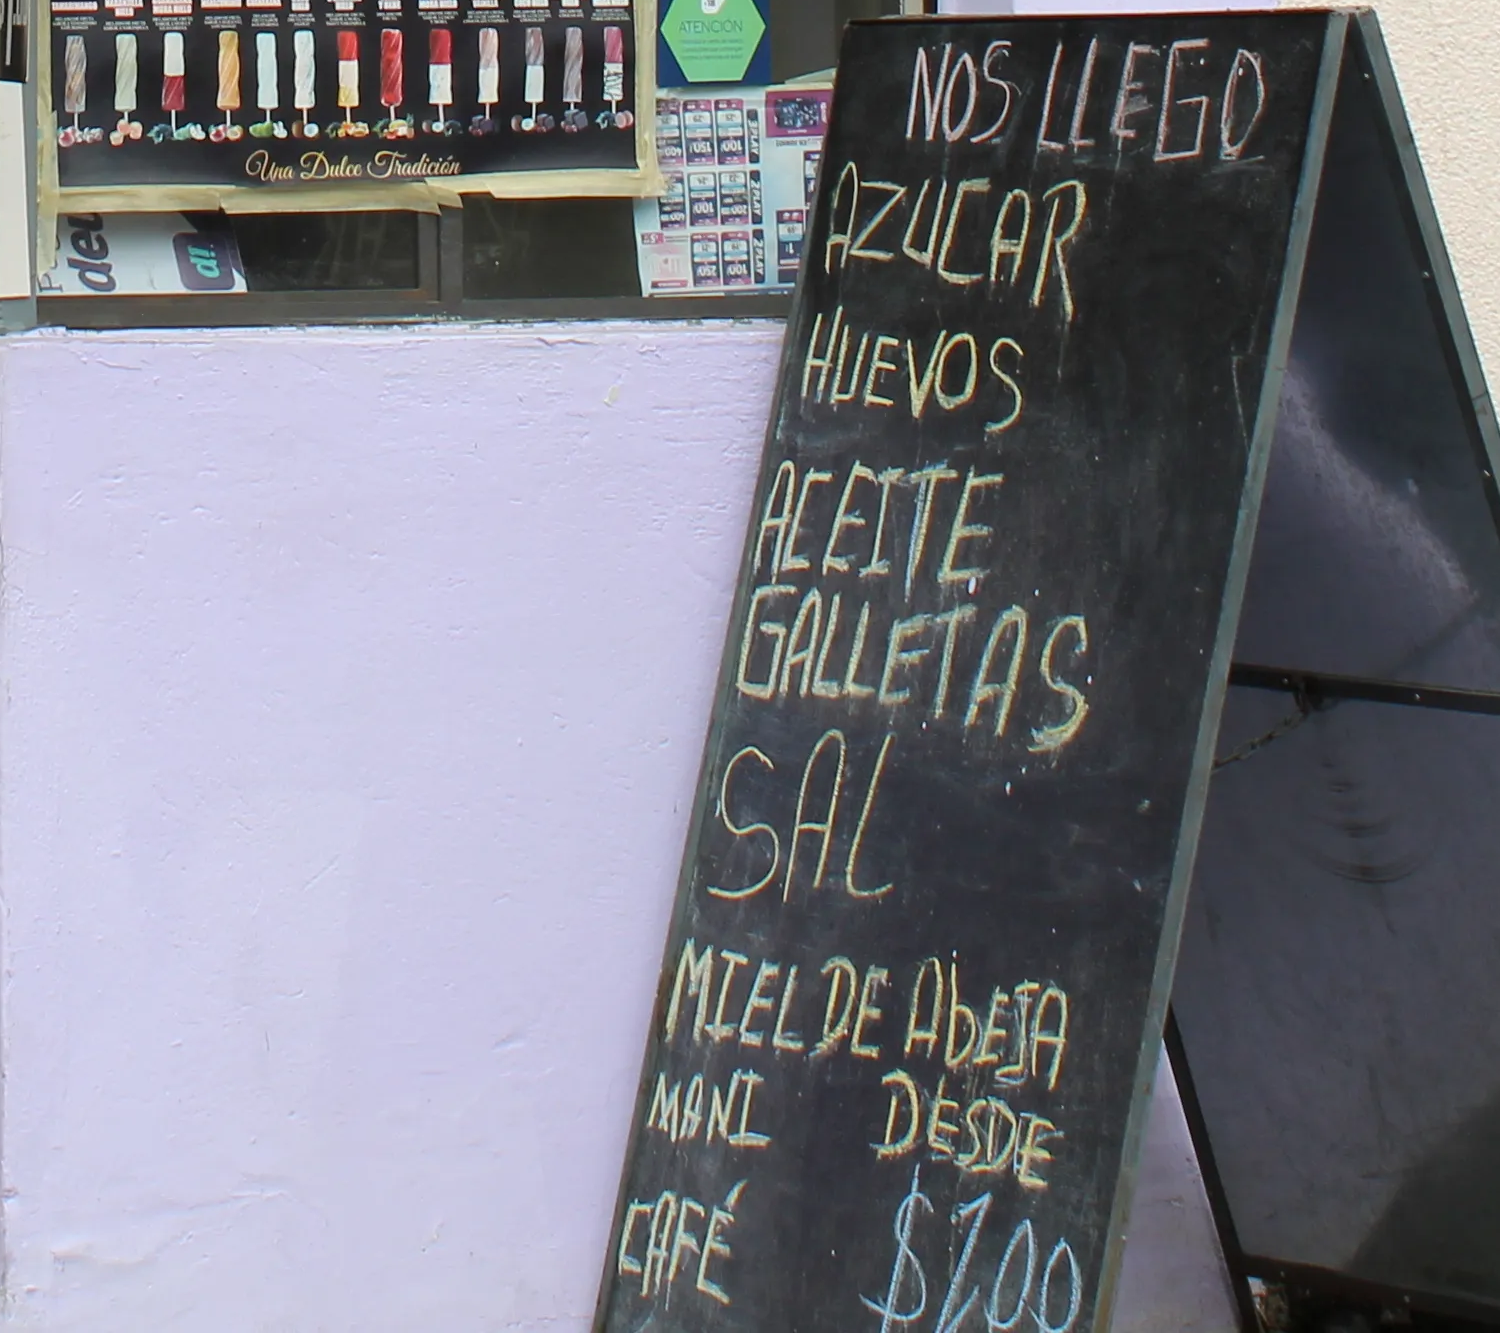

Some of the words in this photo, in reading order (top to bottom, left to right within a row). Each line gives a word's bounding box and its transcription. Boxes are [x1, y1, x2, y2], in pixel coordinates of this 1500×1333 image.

[906, 39, 1014, 144] NOS
[246, 150, 295, 182] Una
[300, 151, 362, 181] Dulce
[366, 150, 461, 178] Tradición
[825, 160, 1088, 323] AZUCAR
[801, 306, 1024, 435] HUEVOS
[753, 460, 1004, 603] ACEITE
[736, 584, 1090, 753] GALLETAS
[706, 728, 895, 903] SAL
[664, 937, 804, 1052] MIEL
[808, 955, 889, 1060] DE
[870, 1069, 1064, 1190] DESDE
[617, 1179, 747, 1311] CAFÉ
